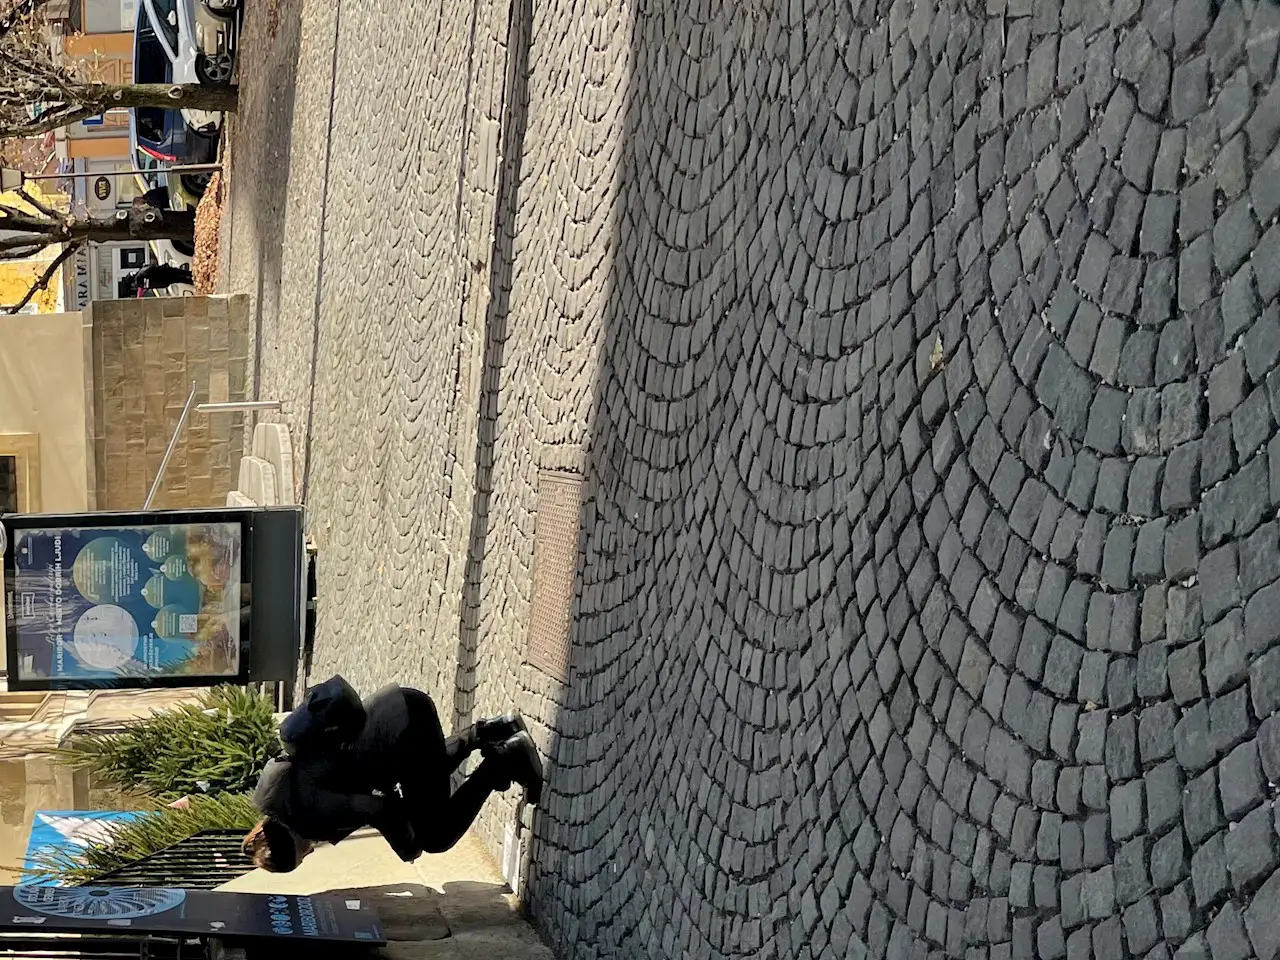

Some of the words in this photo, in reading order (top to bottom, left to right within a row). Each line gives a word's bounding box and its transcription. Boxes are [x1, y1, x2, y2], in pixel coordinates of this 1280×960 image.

[78, 280, 88, 311] ARA
[54, 536, 62, 562] LJUDI
[54, 563, 62, 595] DOBRIH
